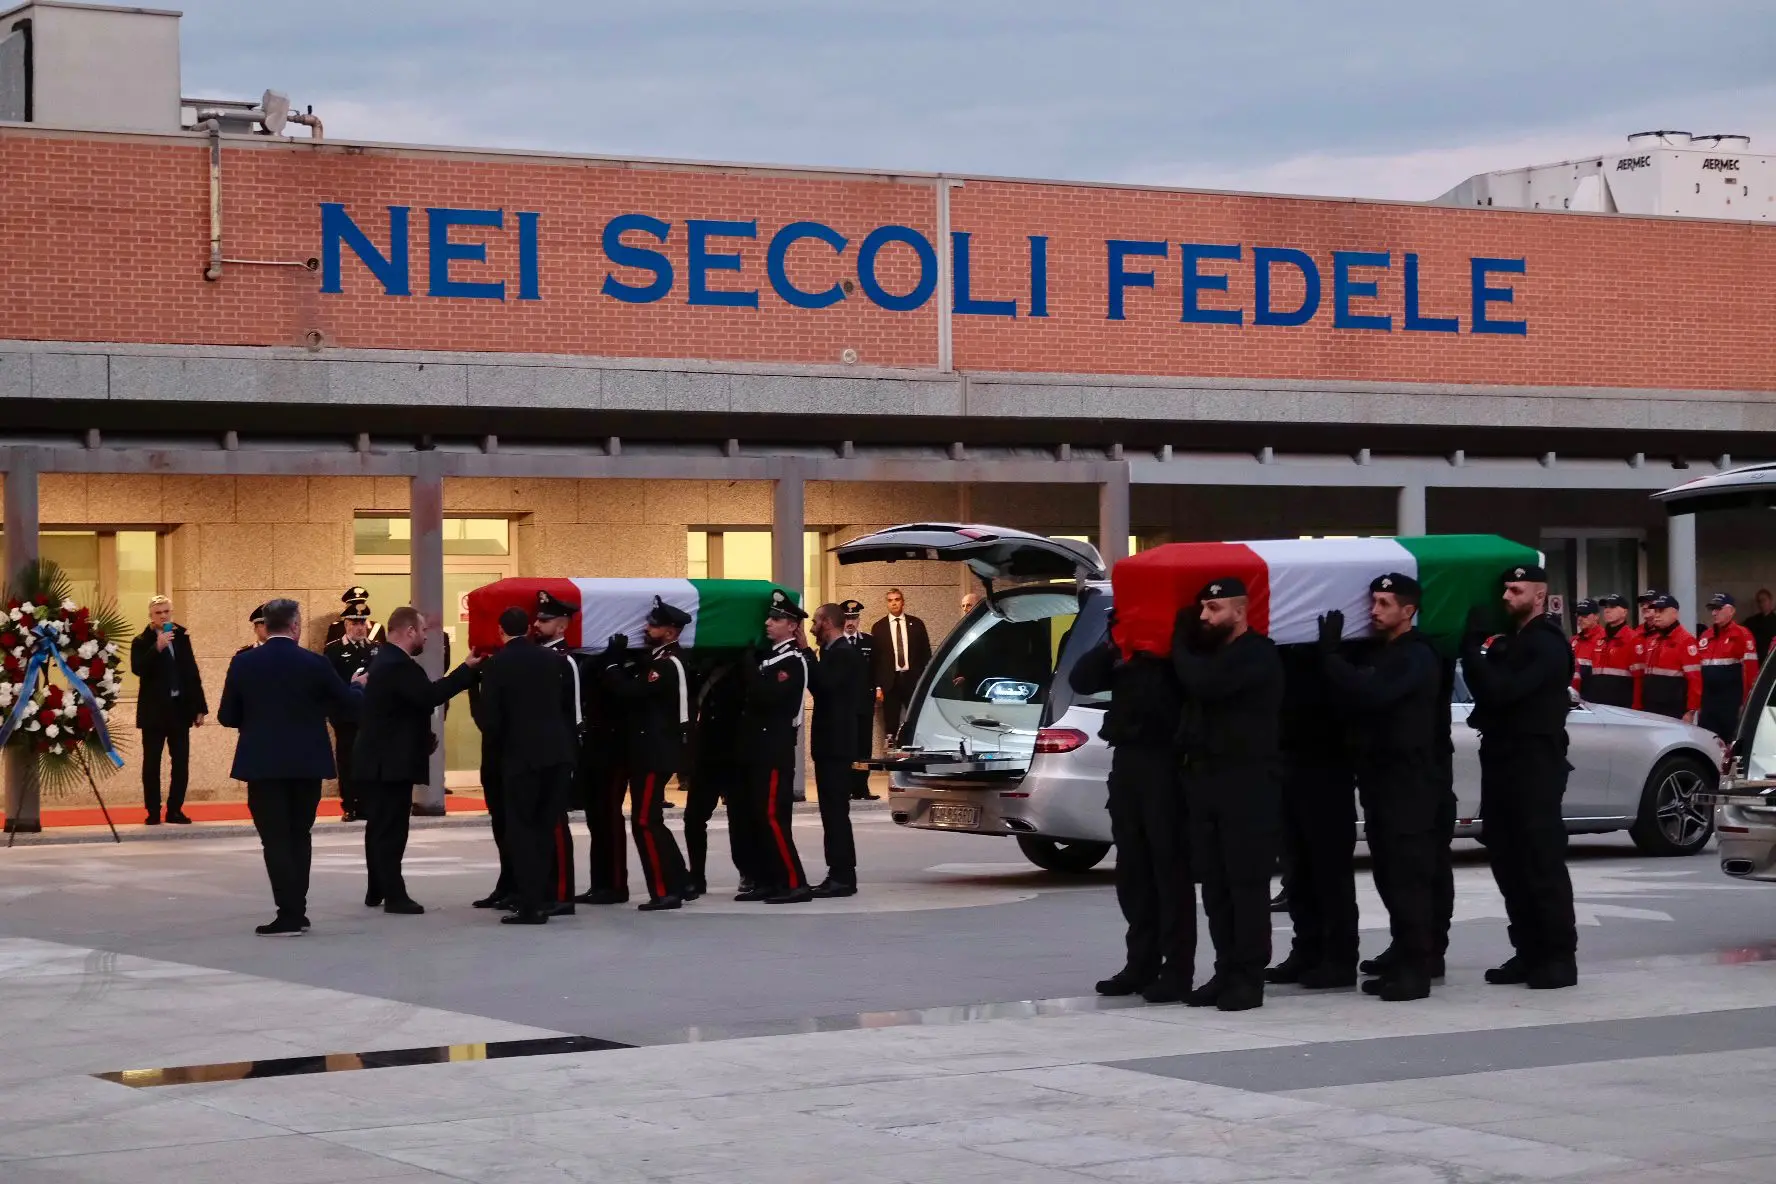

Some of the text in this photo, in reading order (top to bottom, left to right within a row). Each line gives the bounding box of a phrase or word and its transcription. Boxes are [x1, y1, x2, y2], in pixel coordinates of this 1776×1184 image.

[1616, 155, 1651, 171] AERMEC
[1702, 158, 1740, 172] AERMEC
[319, 202, 1528, 337] NEI SECOLI FEDELE
